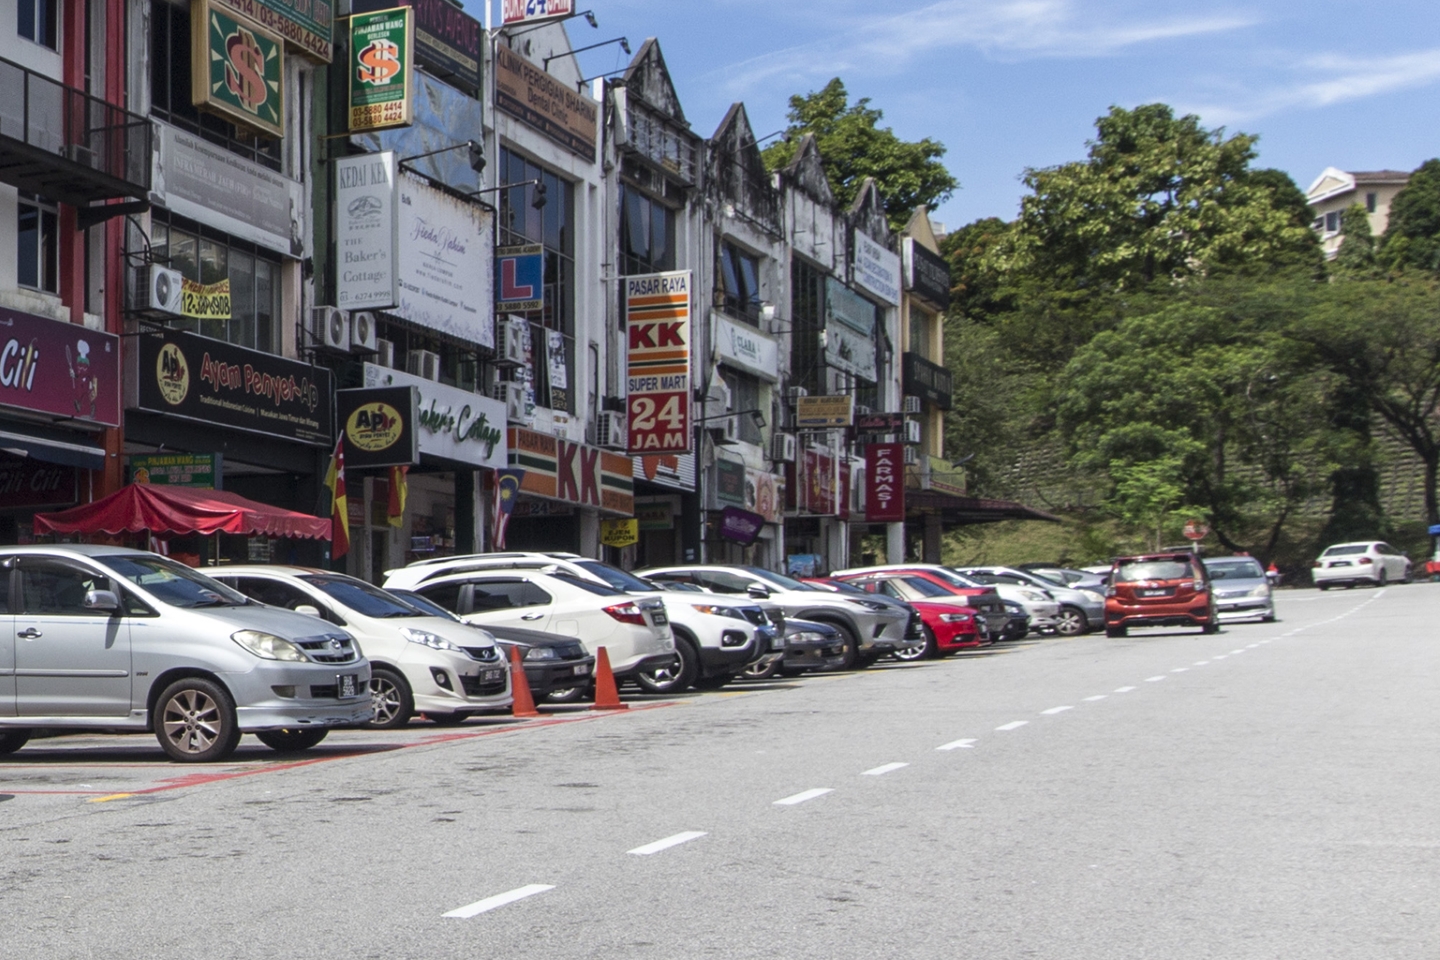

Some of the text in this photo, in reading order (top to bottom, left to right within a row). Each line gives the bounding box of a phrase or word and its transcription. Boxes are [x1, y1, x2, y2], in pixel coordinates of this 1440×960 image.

[260, 7, 303, 41] 03-5880
[304, 32, 330, 57] 4424
[385, 19, 403, 29] WANG
[523, 65, 565, 103] PERGIGIAN
[384, 101, 402, 112] 4414
[384, 111, 402, 122] 4424
[340, 164, 367, 189] KEDAI
[344, 238, 363, 246] THE
[345, 249, 387, 264] Baker's
[343, 270, 387, 284] Cottage
[501, 258, 533, 300] L
[629, 276, 687, 296] PASAR RAYA
[629, 321, 687, 350] KK
[200, 352, 242, 393] Ayam
[628, 375, 687, 392] SUPER MART
[631, 395, 684, 432] 24
[632, 432, 684, 450] JAM
[558, 440, 600, 507] KK
[875, 449, 893, 509] FARMASI
